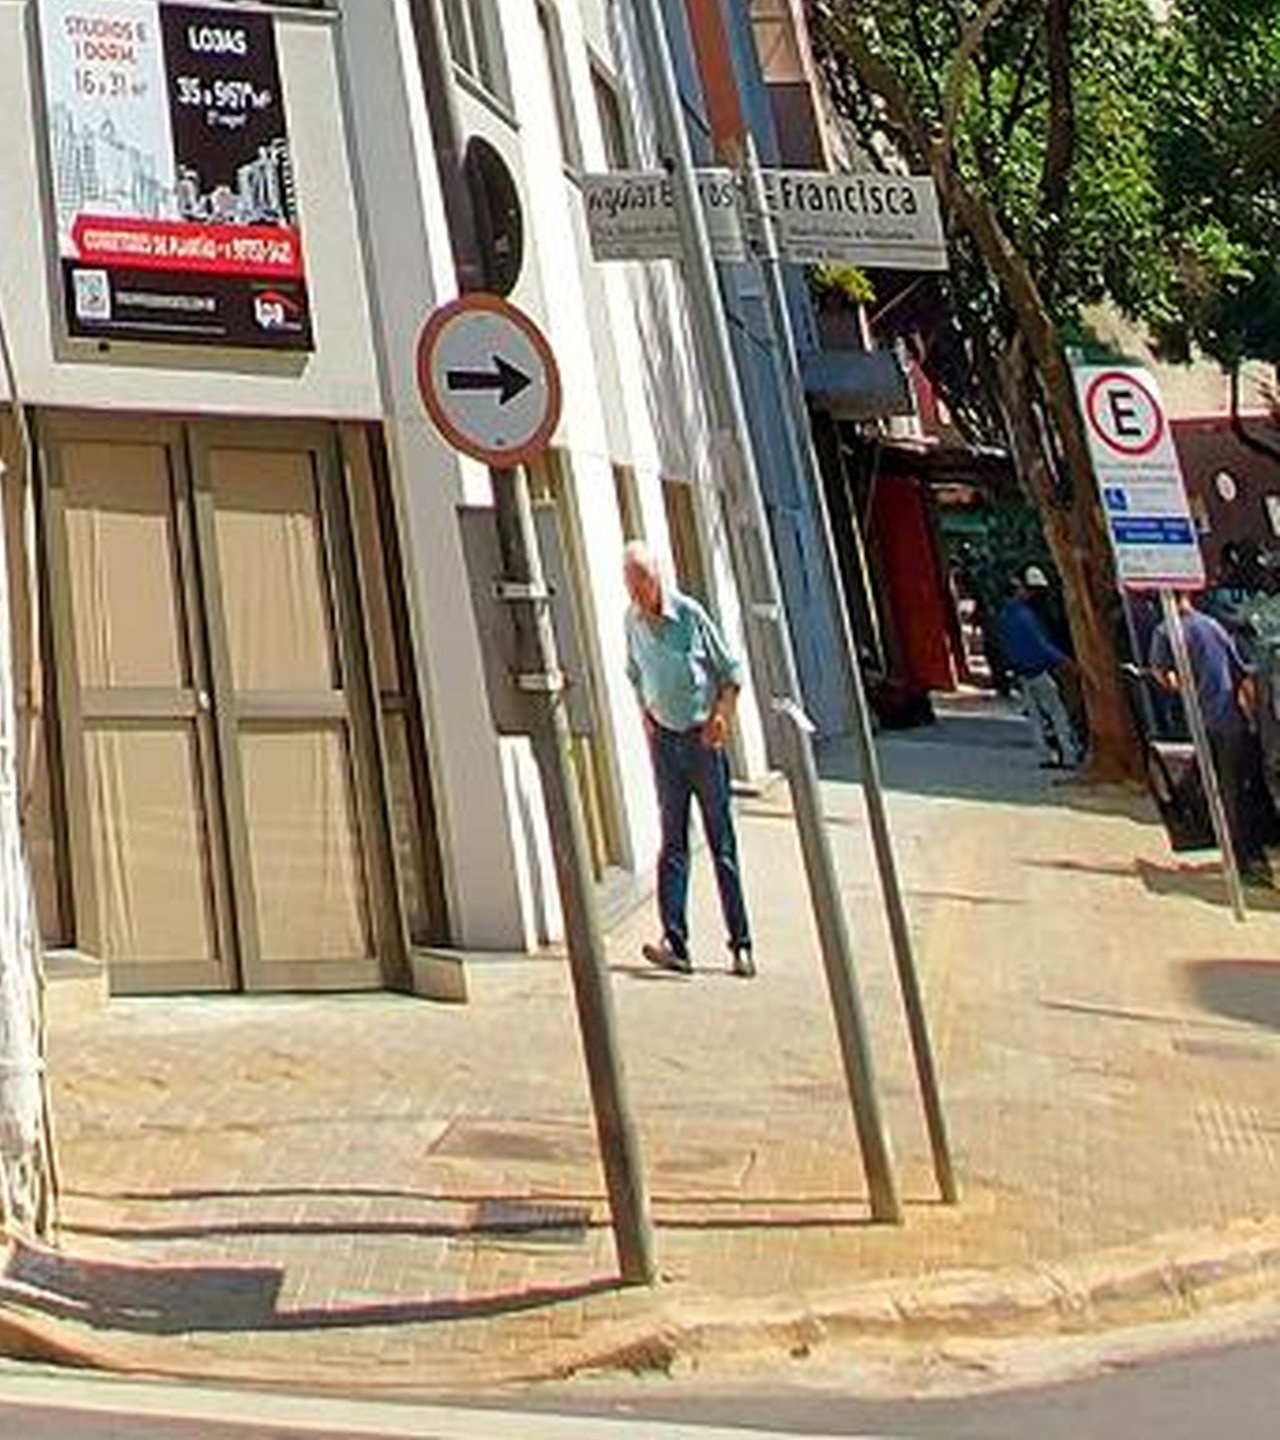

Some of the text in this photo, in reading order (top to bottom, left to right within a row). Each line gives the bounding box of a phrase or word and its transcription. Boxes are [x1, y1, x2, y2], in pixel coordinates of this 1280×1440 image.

[64, 15, 133, 41] STUDIOS
[189, 26, 247, 54] LOJAS
[176, 77, 201, 105] 35
[781, 177, 918, 215] Francisca
[1107, 390, 1142, 436] E
